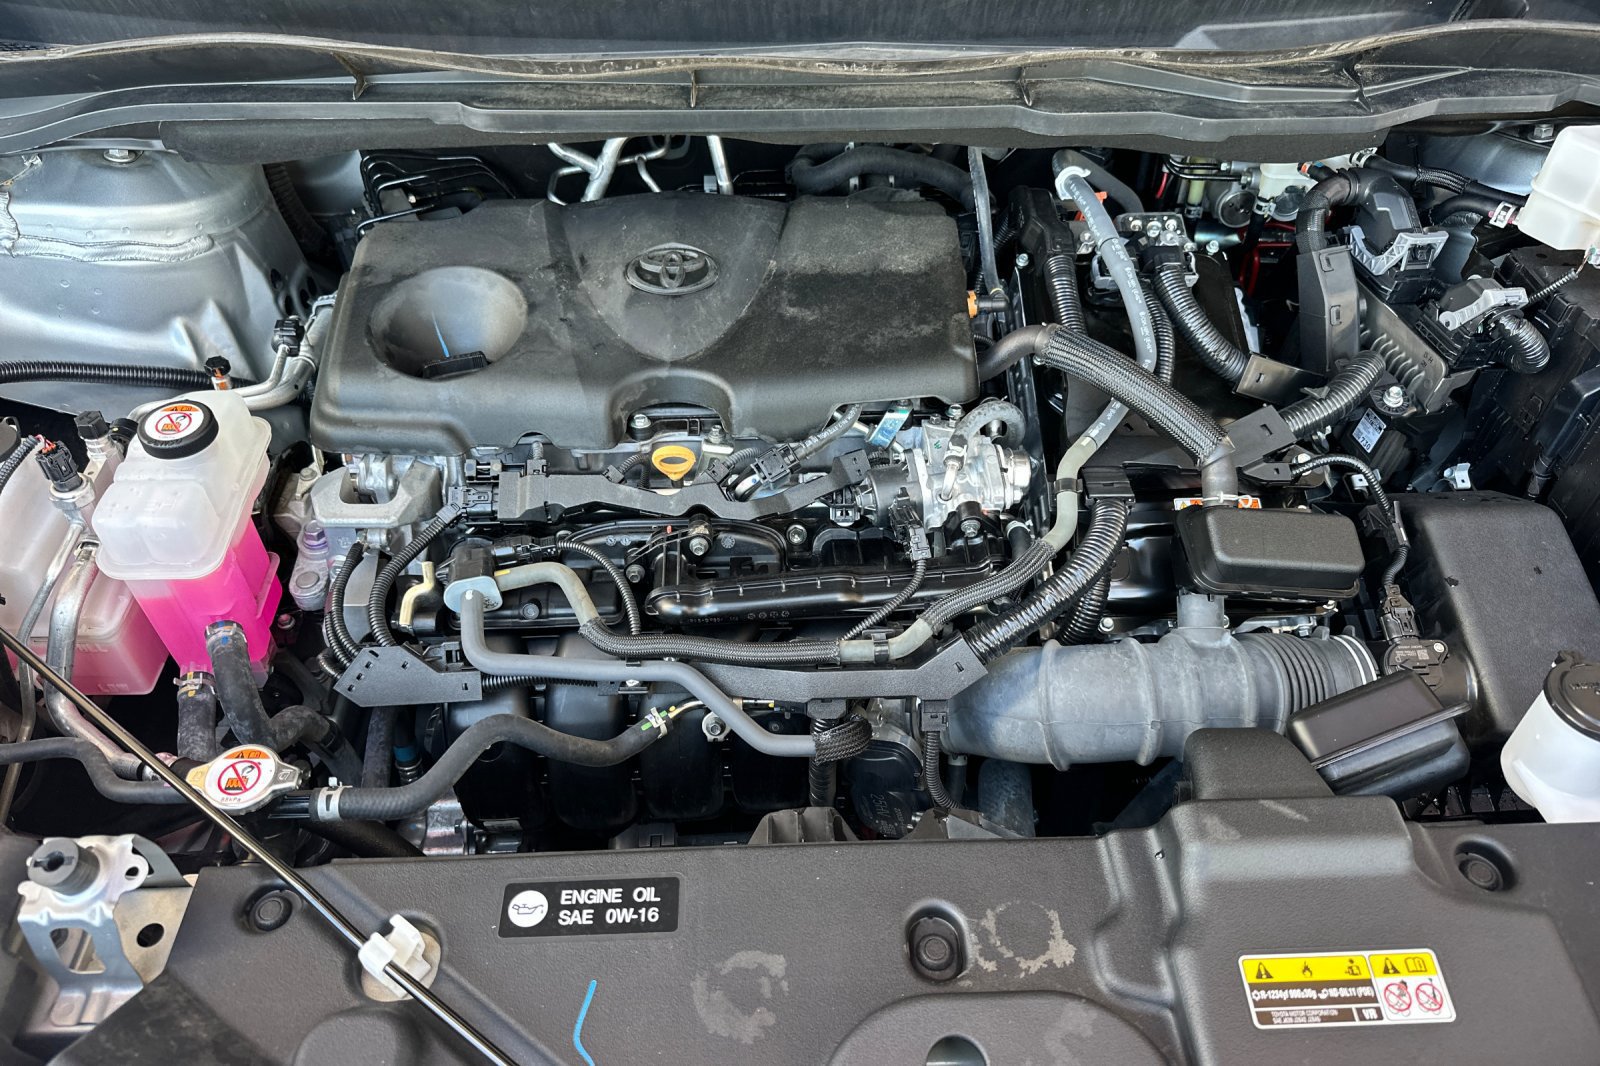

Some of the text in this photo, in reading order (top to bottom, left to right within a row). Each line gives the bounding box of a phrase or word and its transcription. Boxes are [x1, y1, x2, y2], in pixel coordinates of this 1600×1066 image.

[560, 886, 661, 905] ENGINE OIL
[557, 907, 660, 925] SAE 0W-16
